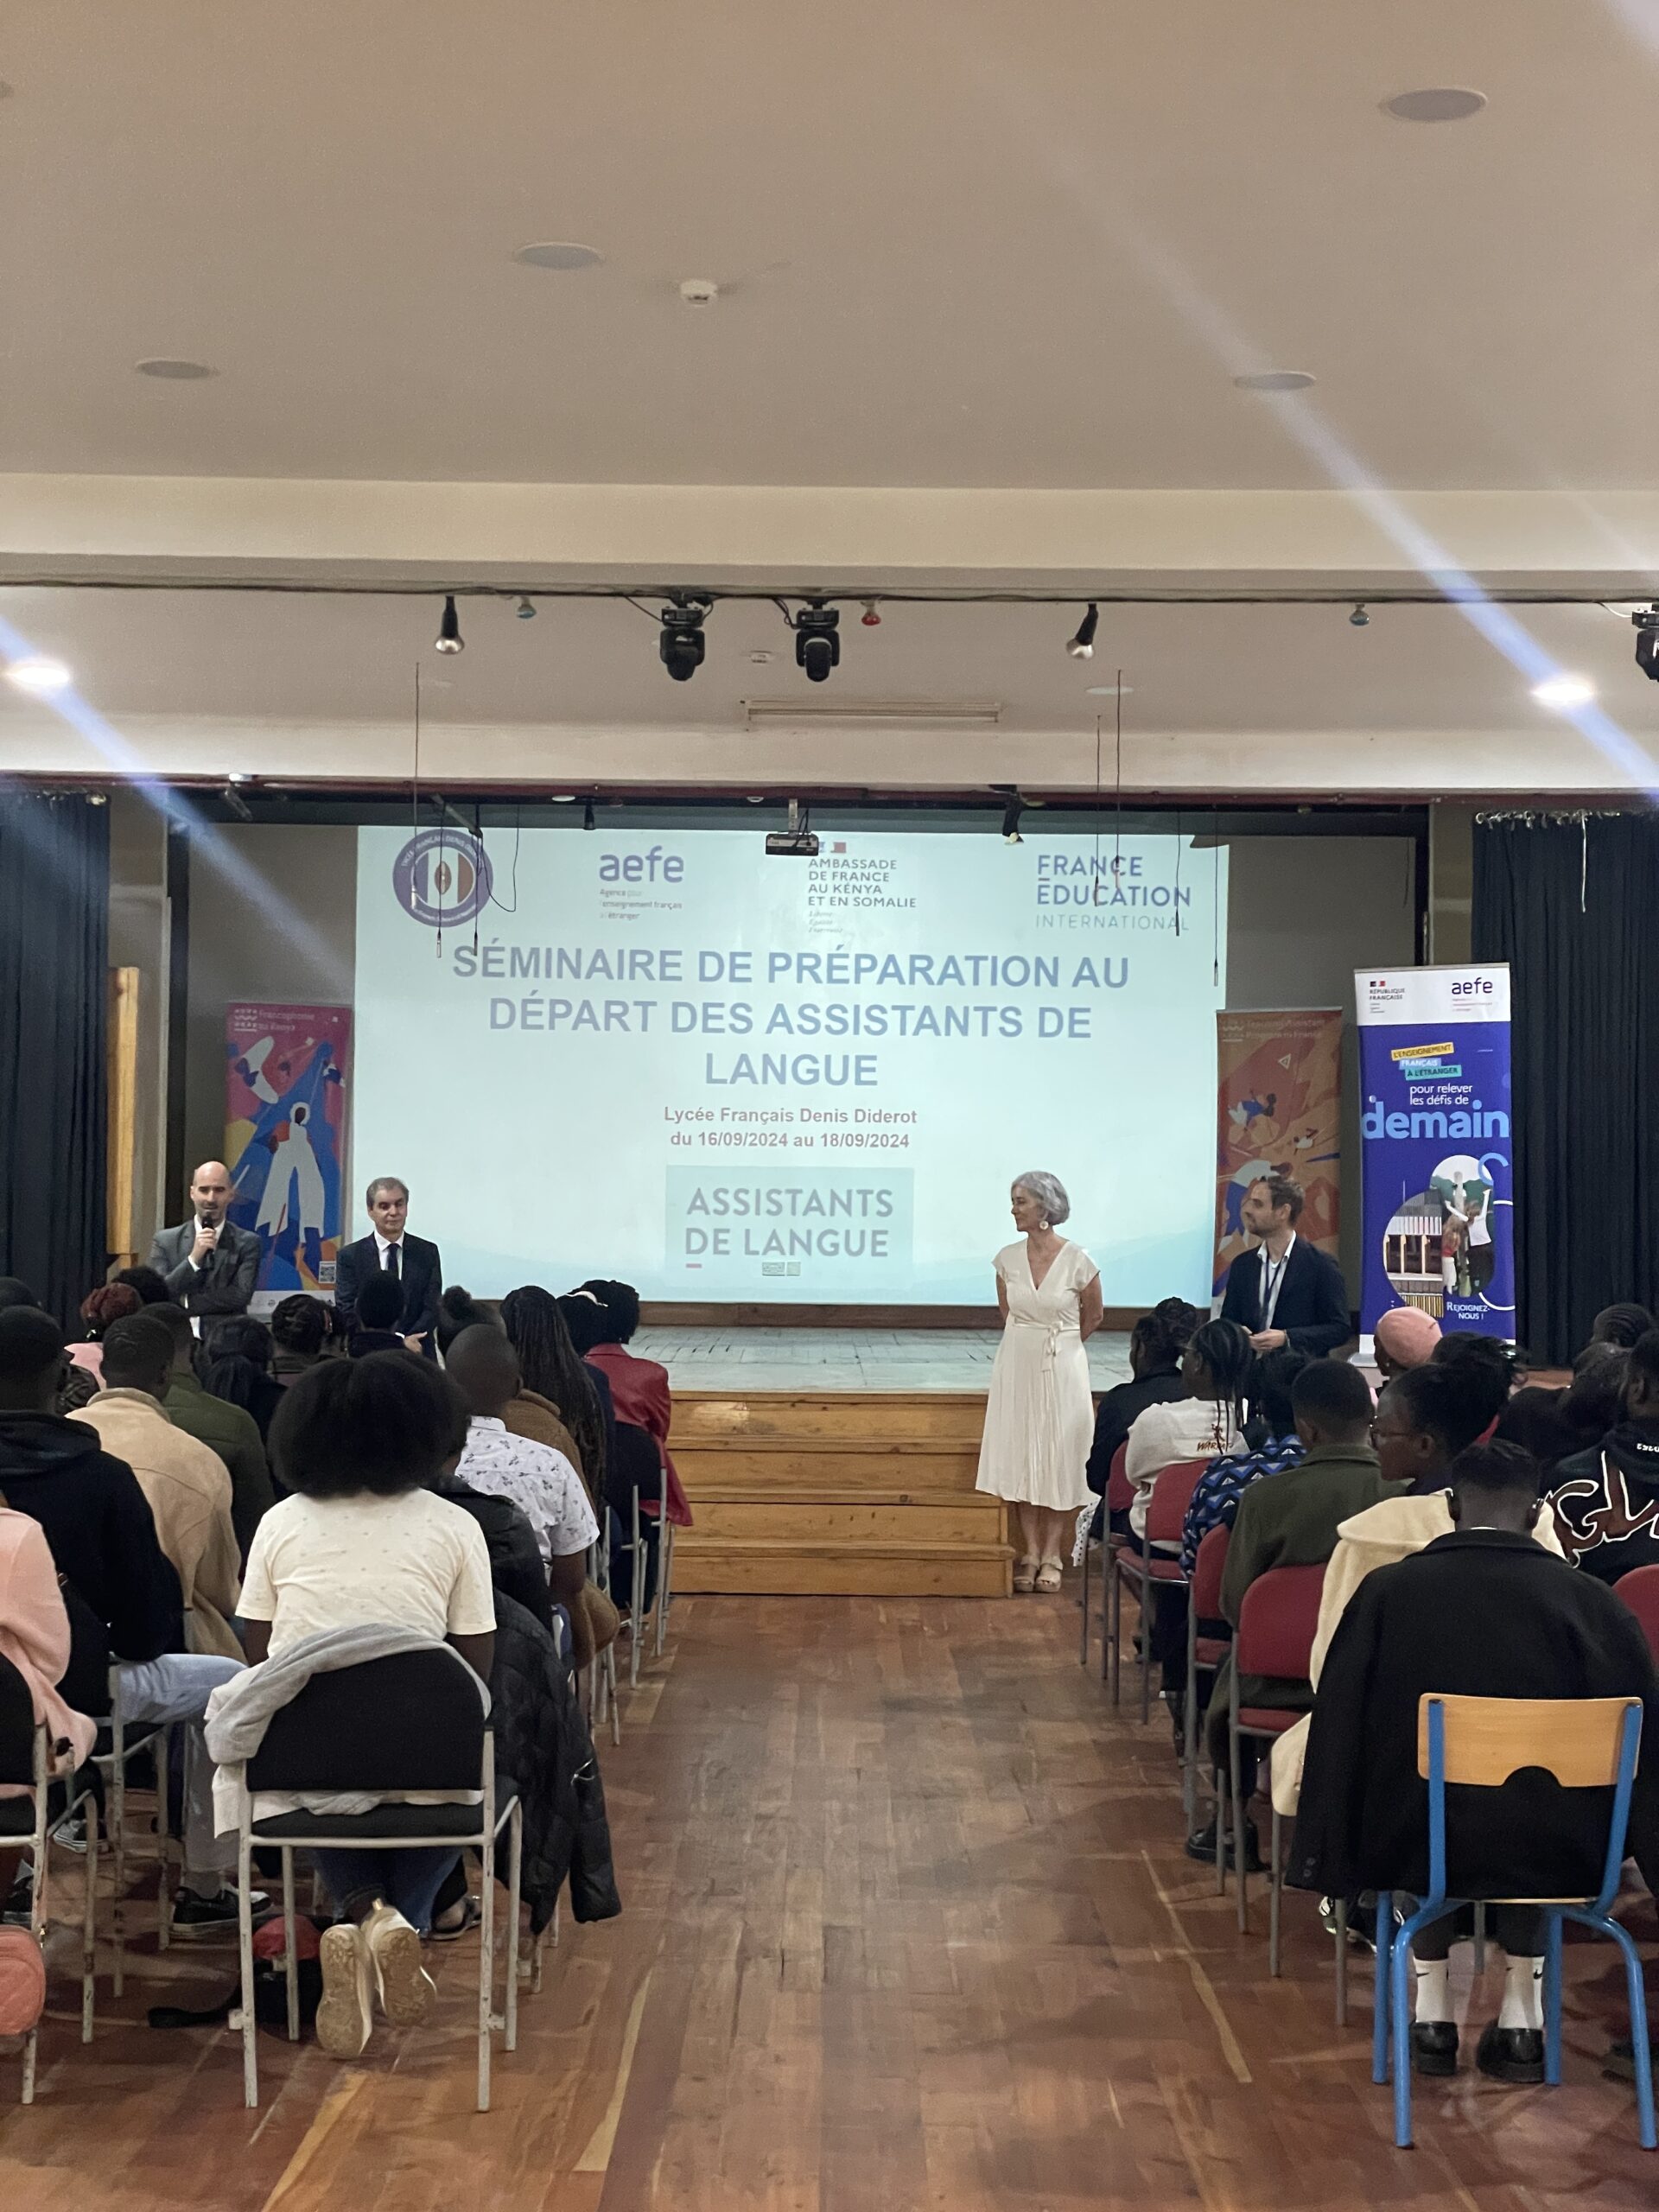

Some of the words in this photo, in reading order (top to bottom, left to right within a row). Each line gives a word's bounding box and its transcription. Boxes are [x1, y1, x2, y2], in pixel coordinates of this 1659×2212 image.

[600, 845, 683, 883] aefe
[809, 859, 897, 869] AMBASSADE
[1038, 855, 1142, 876] FRANCE
[809, 871, 827, 880] DE
[832, 872, 889, 882] FRANCE
[809, 884, 828, 893] AU
[833, 883, 882, 893] KÉNYA
[809, 896, 825, 906] ET
[830, 897, 849, 906] EN
[853, 897, 917, 907] SOMALIE
[1036, 913, 1190, 931] INTERNATIONAL
[453, 938, 683, 982] SÉMINAIRE
[698, 950, 753, 982] DE
[768, 944, 1059, 988] PRÉPARATION
[1071, 957, 1128, 988] AU
[1452, 977, 1493, 995] aefe
[490, 989, 657, 1033] DÉPART
[671, 1001, 753, 1034] DES
[765, 1003, 1023, 1038] ASSISTANTS
[1038, 1007, 1091, 1039] DE
[1393, 1044, 1452, 1058] L'ENSEIGNEMENT
[706, 1053, 878, 1086] LANGUE
[1410, 1085, 1434, 1096] pour
[1438, 1084, 1472, 1093] relever
[1410, 1094, 1424, 1105] les
[1427, 1094, 1452, 1105] défis
[1455, 1095, 1469, 1104] de
[664, 1107, 715, 1124] Lycée
[721, 1108, 794, 1125] Français
[800, 1109, 848, 1123] Denis
[855, 1109, 917, 1123] Diderot
[1362, 1100, 1510, 1139] demain
[671, 1132, 691, 1146] du
[698, 1132, 788, 1147] 16/09/2024
[793, 1135, 814, 1147] au
[821, 1134, 910, 1147] 18/09/2024
[687, 1187, 893, 1217] ASSISTANTS
[685, 1228, 730, 1255] DE
[744, 1229, 889, 1256] LANGUE
